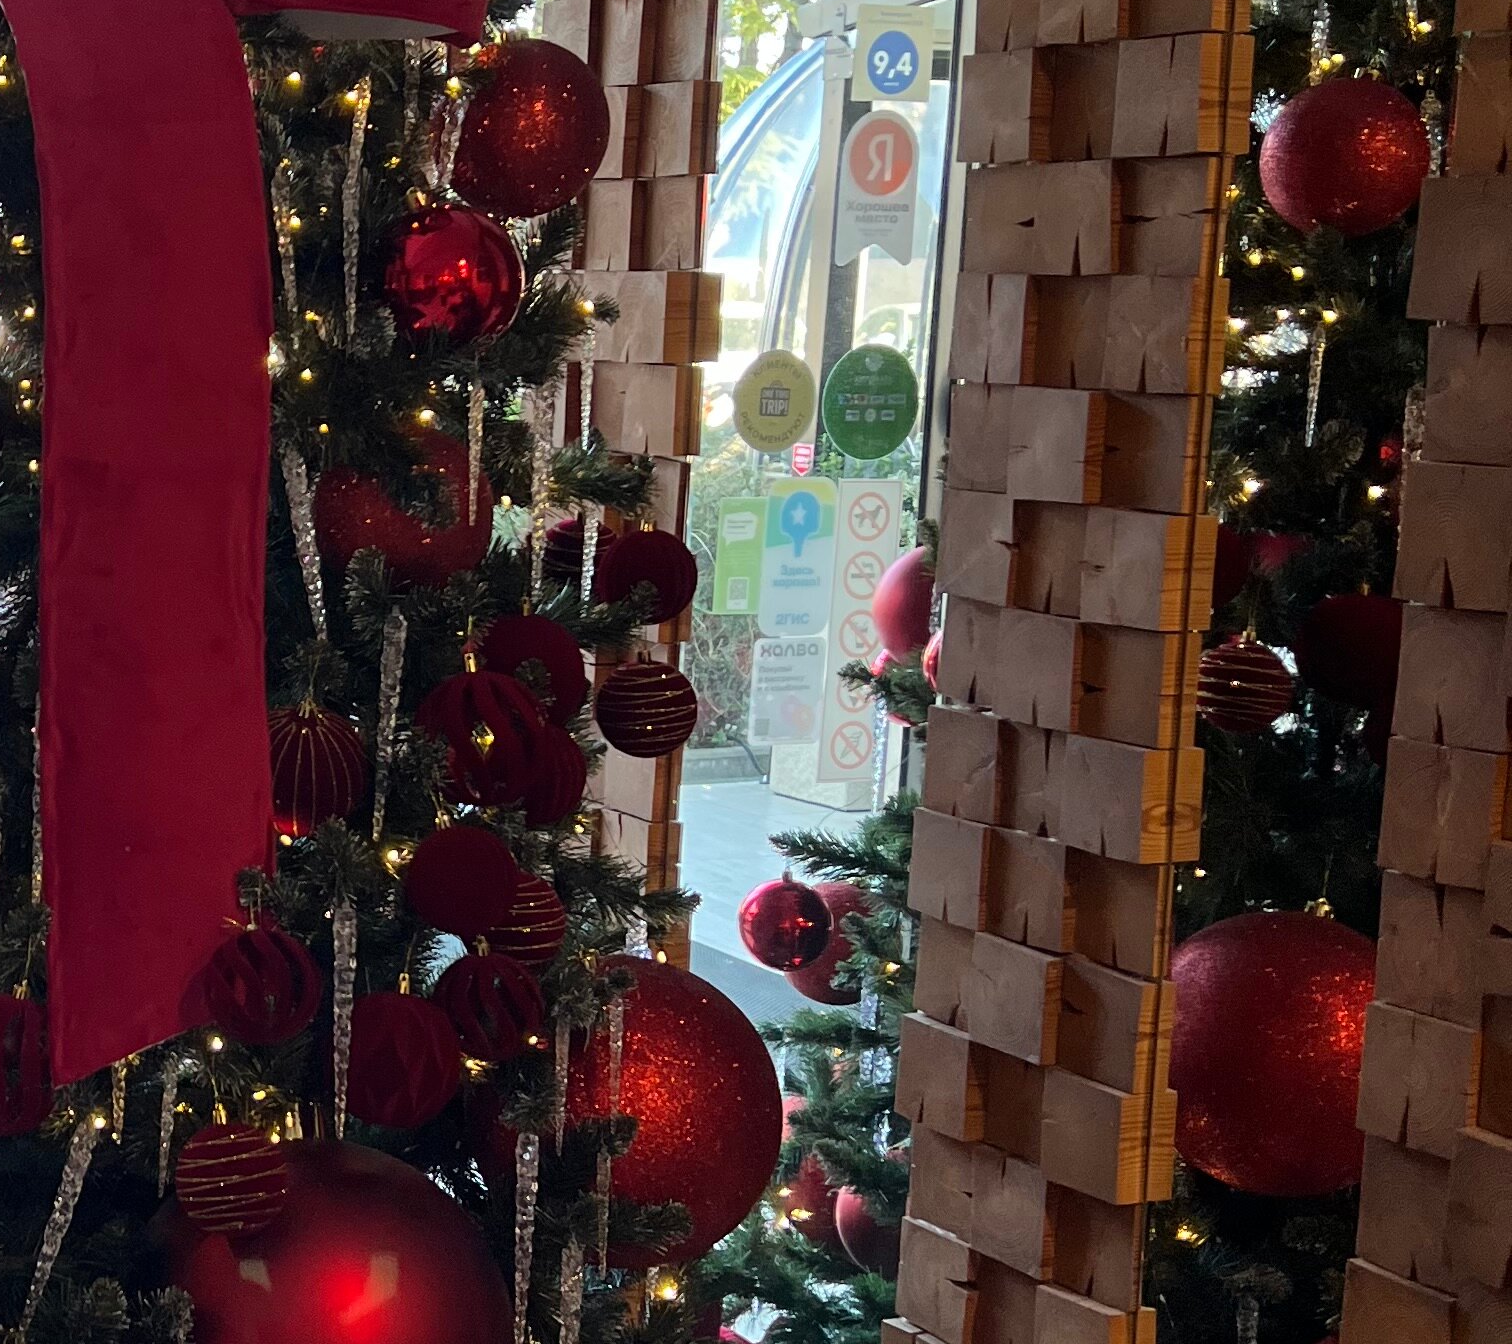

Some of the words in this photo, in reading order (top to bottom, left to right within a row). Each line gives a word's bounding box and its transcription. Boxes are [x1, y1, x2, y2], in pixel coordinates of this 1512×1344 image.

[873, 50, 912, 78] 9,4
[761, 399, 789, 415] TRIP!
[775, 613, 810, 625] 2ГИС
